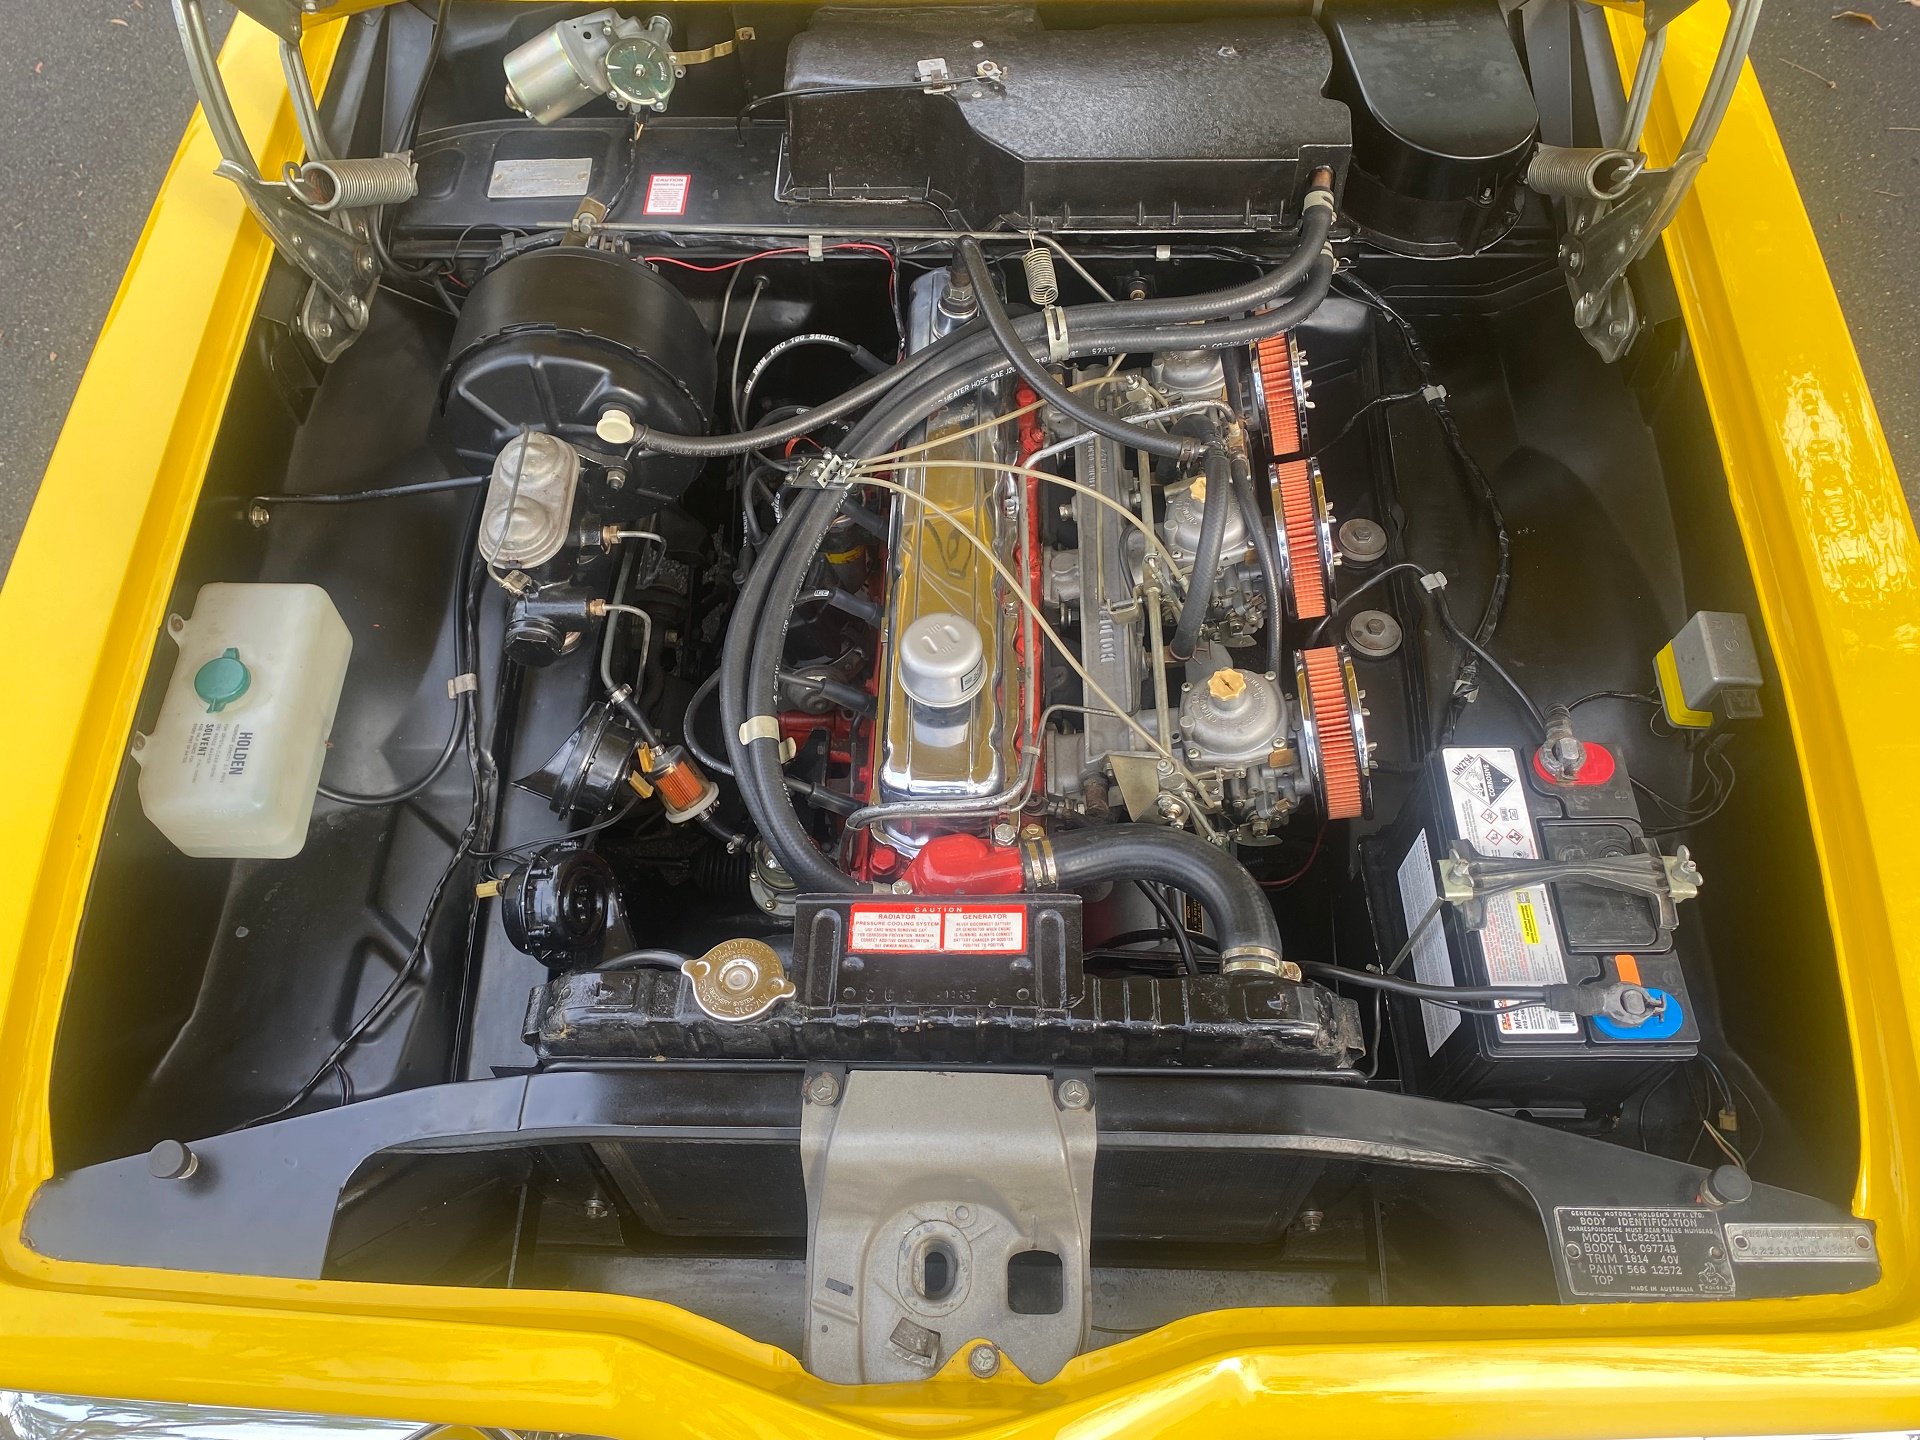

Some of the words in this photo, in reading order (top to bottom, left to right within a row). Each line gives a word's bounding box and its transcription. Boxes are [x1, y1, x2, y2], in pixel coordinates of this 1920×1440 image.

[770, 341, 786, 356] PRO
[809, 333, 840, 344] SERIES
[944, 384, 970, 403] HEATER
[971, 376, 988, 389] HOSE
[990, 369, 1004, 382] SAE
[197, 723, 214, 757] SOLVENT
[229, 732, 253, 775] HOLDEN
[1452, 754, 1474, 776] UN2794
[1482, 763, 1496, 798] CORROSIVE
[1421, 832, 1431, 872] DANGER
[732, 995, 755, 1008] SYSTEM
[1580, 1217, 1606, 1226] BODY
[1618, 1217, 1698, 1228] IDENTIFICATION
[1582, 1233, 1622, 1243] MODEL
[1584, 1243, 1614, 1253] BODY
[1587, 1254, 1618, 1264] TRIM
[1624, 1254, 1649, 1263] 1814
[1660, 1255, 1679, 1264] 40V
[1589, 1265, 1624, 1275] PAINT
[1627, 1265, 1647, 1274] 568
[1652, 1265, 1683, 1275] 12572
[1592, 1275, 1614, 1285] TOP
